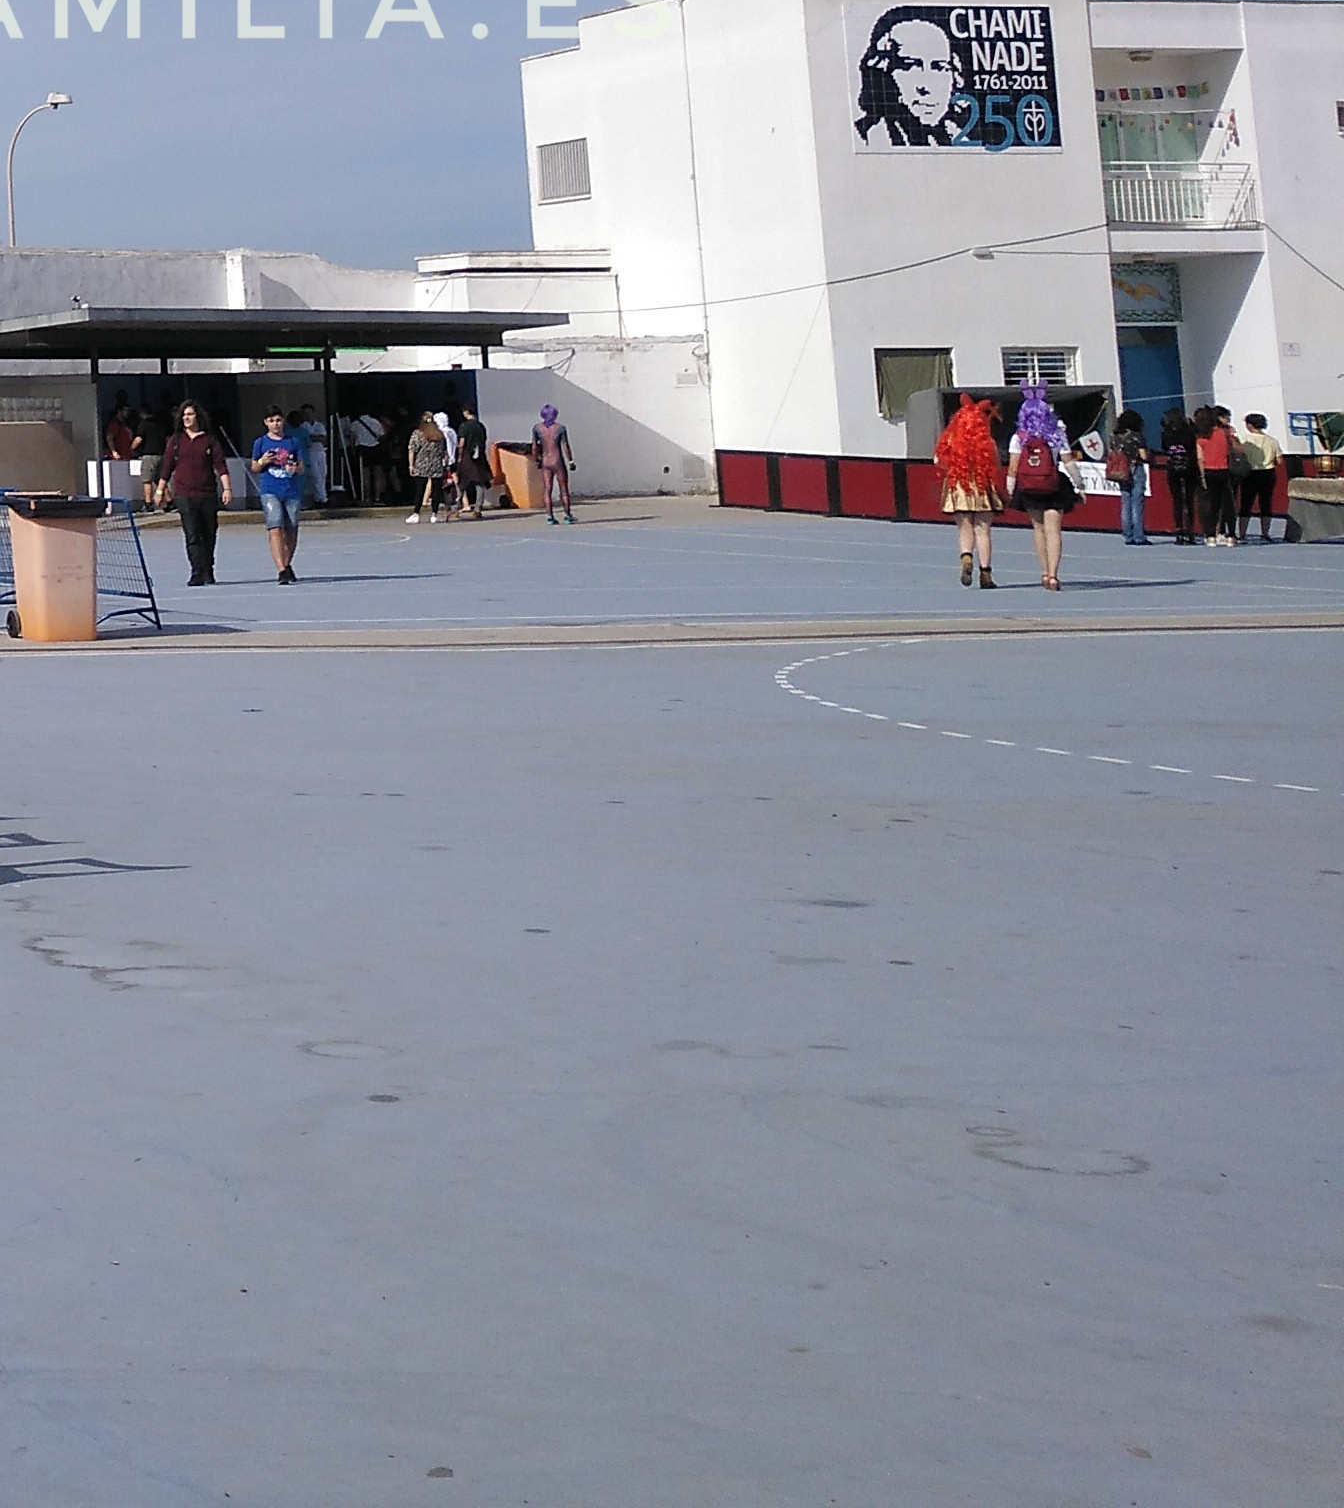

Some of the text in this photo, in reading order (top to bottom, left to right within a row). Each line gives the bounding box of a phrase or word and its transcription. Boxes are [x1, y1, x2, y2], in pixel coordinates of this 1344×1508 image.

[949, 8, 1046, 39] CHAMI-
[970, 41, 1047, 71] NADE
[972, 74, 1048, 90] 1761-2011
[949, 94, 1054, 152] 250
